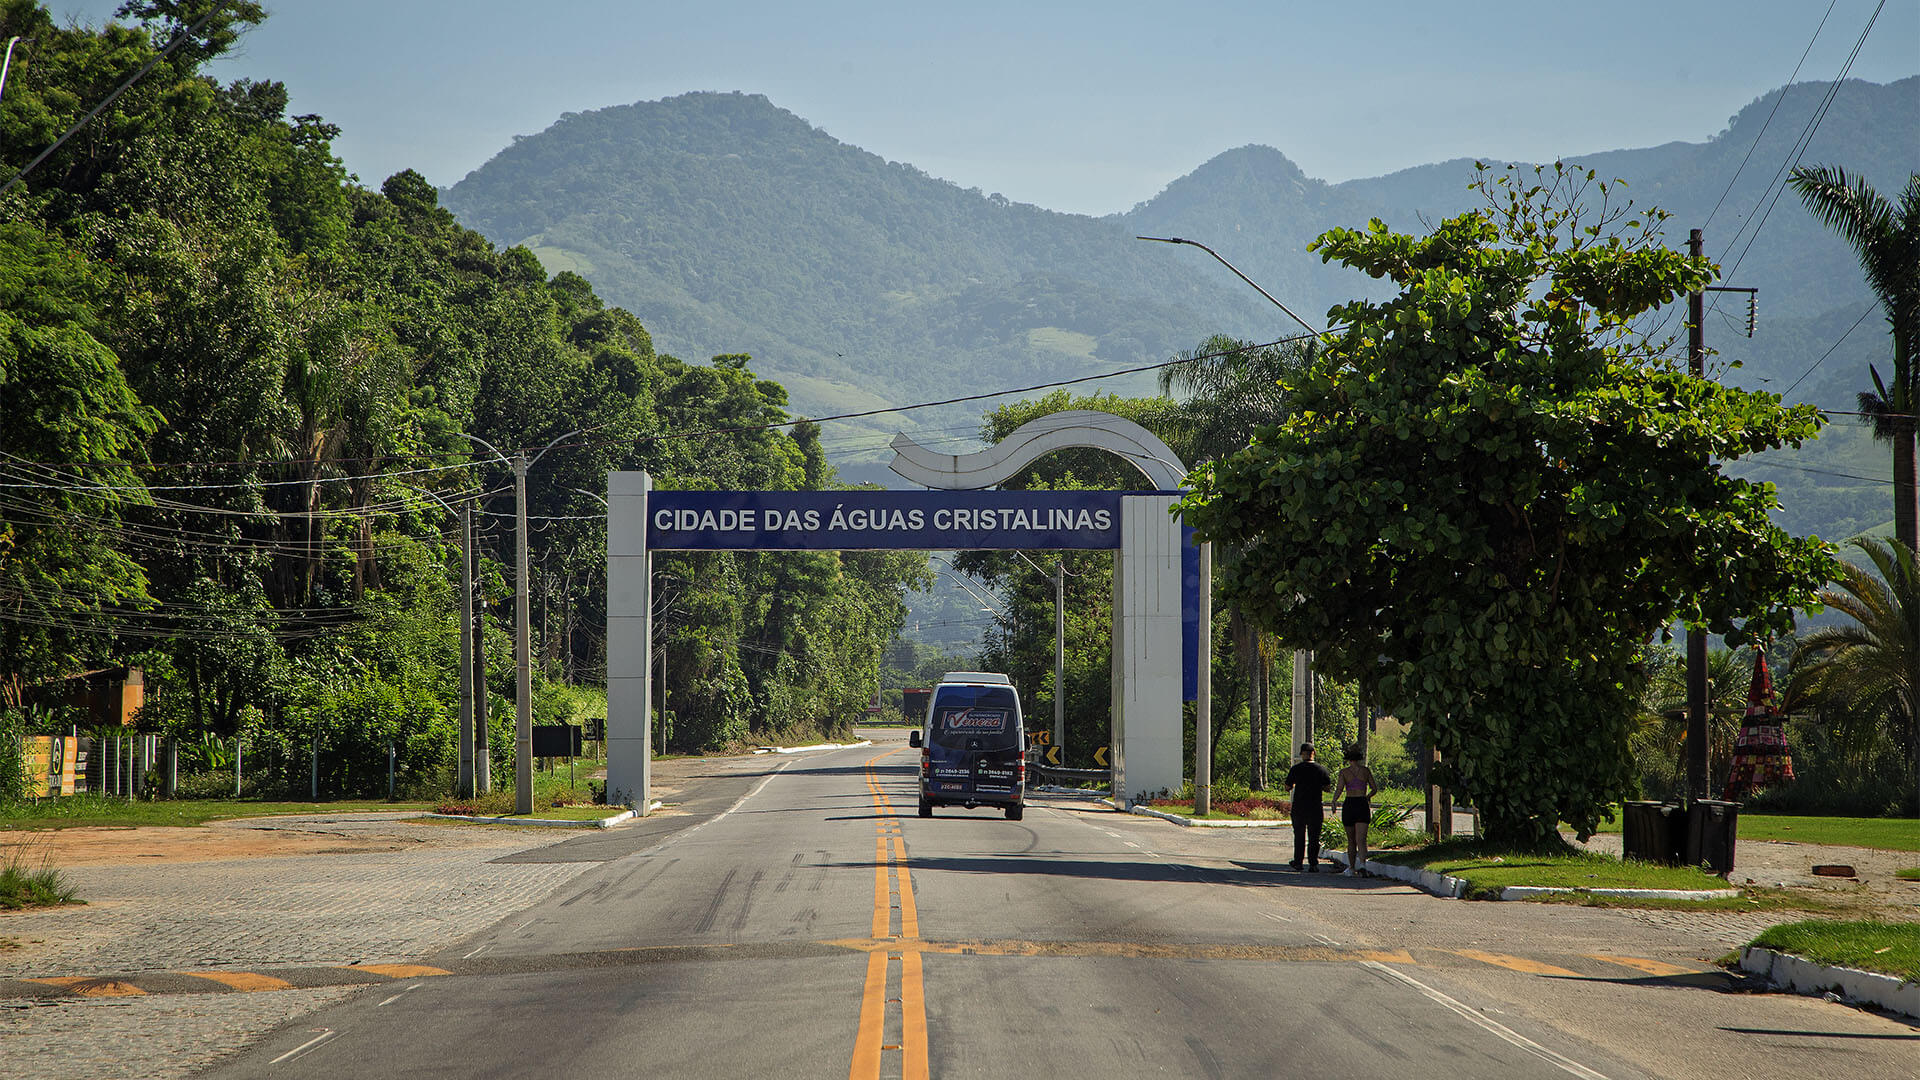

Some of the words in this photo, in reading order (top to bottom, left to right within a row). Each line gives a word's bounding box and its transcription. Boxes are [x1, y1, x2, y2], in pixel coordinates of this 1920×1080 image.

[654, 509, 756, 531] CIDADE
[764, 509, 821, 531] DAS
[828, 503, 925, 531] ÁGUAS
[933, 508, 1112, 531] CRISTALINAS
